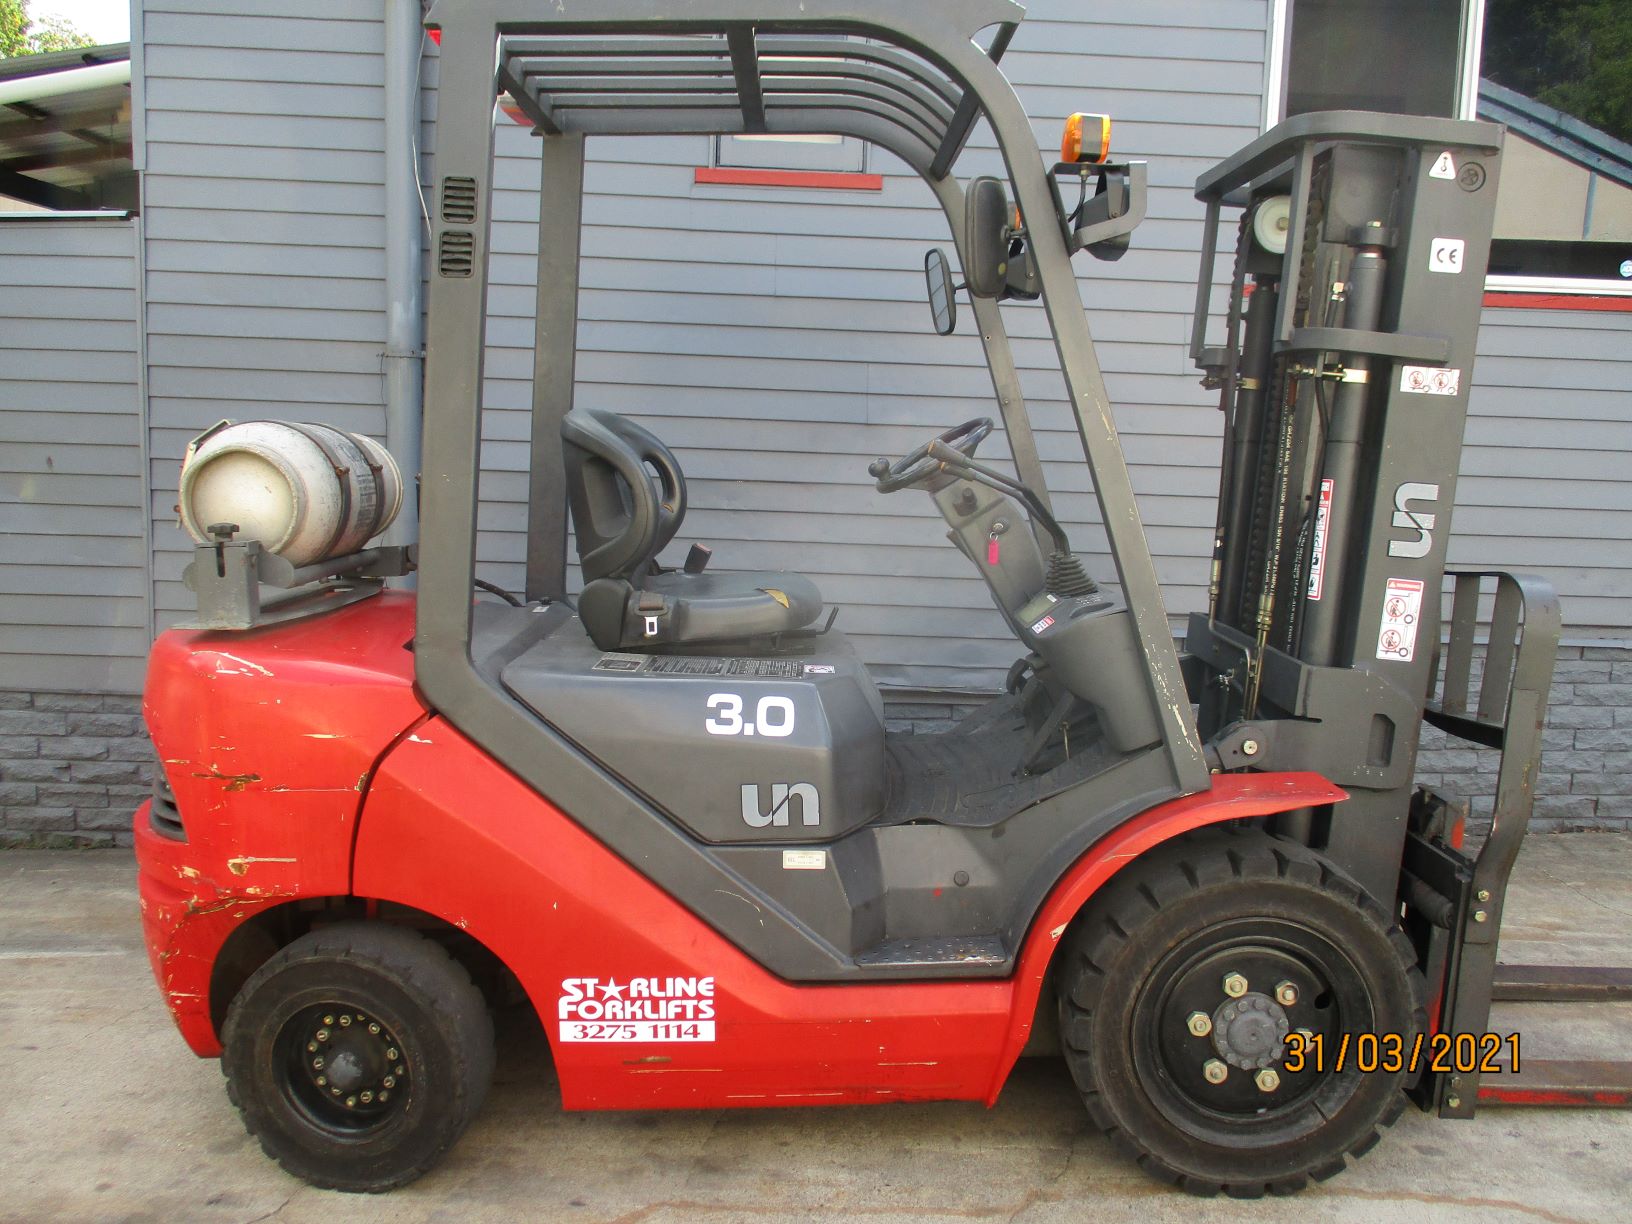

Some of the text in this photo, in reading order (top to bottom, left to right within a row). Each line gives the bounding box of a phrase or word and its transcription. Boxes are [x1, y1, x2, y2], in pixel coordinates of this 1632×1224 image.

[1436, 247, 1458, 264] CE
[705, 693, 795, 737] 3.0
[558, 997, 716, 1020] FORKLIFTS
[573, 1023, 701, 1039] 3275 1114
